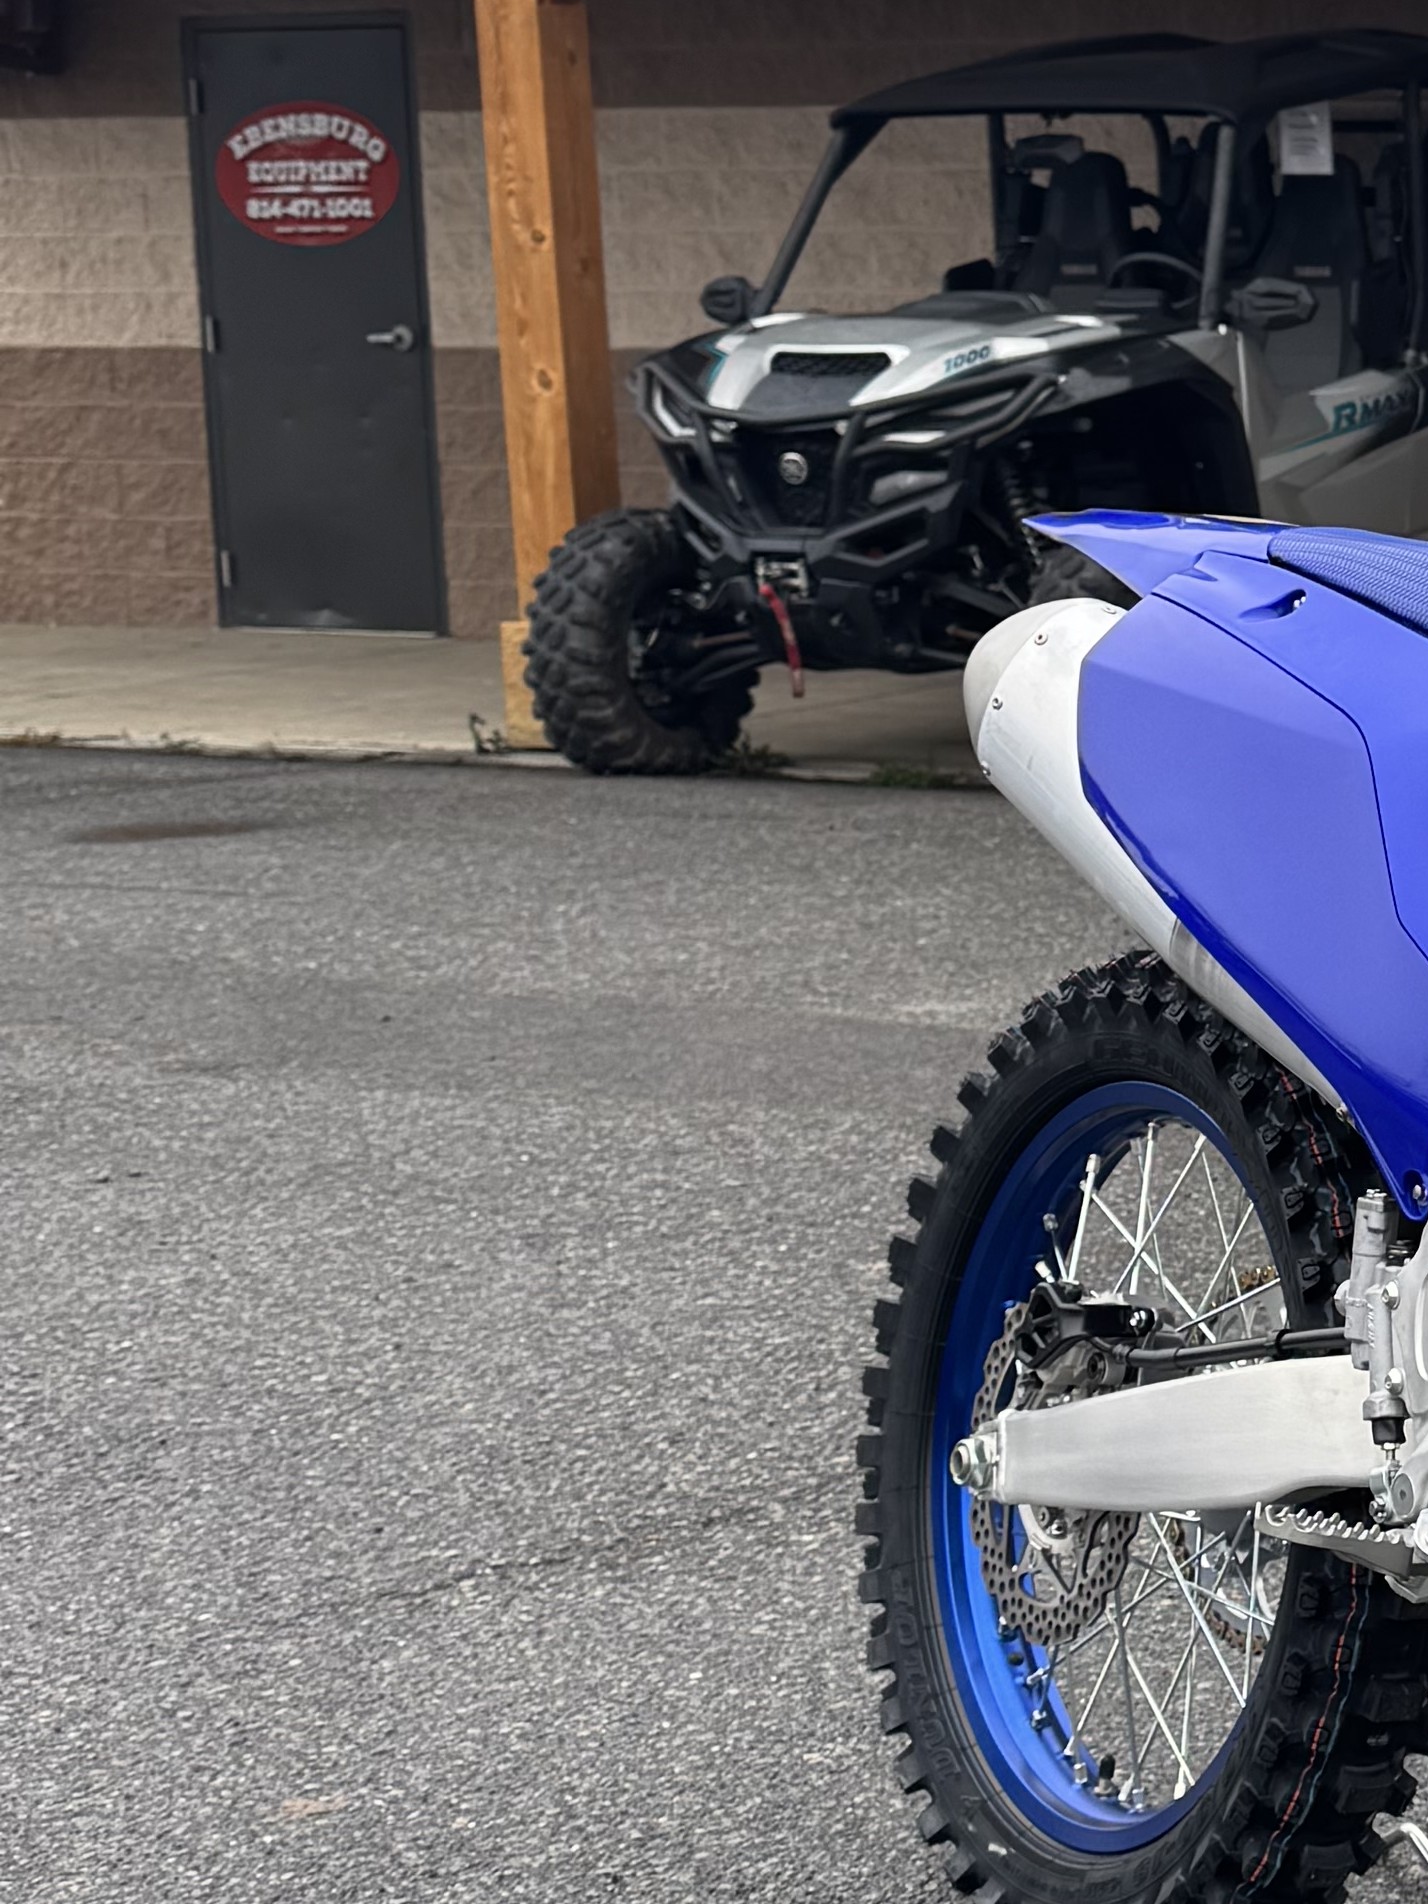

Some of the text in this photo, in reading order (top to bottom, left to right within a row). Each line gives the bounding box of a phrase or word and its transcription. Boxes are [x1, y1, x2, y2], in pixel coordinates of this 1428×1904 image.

[227, 113, 387, 163] EBENSBURG
[247, 159, 370, 183] EQUIPMENT
[246, 198, 374, 219] 814-471-1001
[944, 345, 990, 374] 1000
